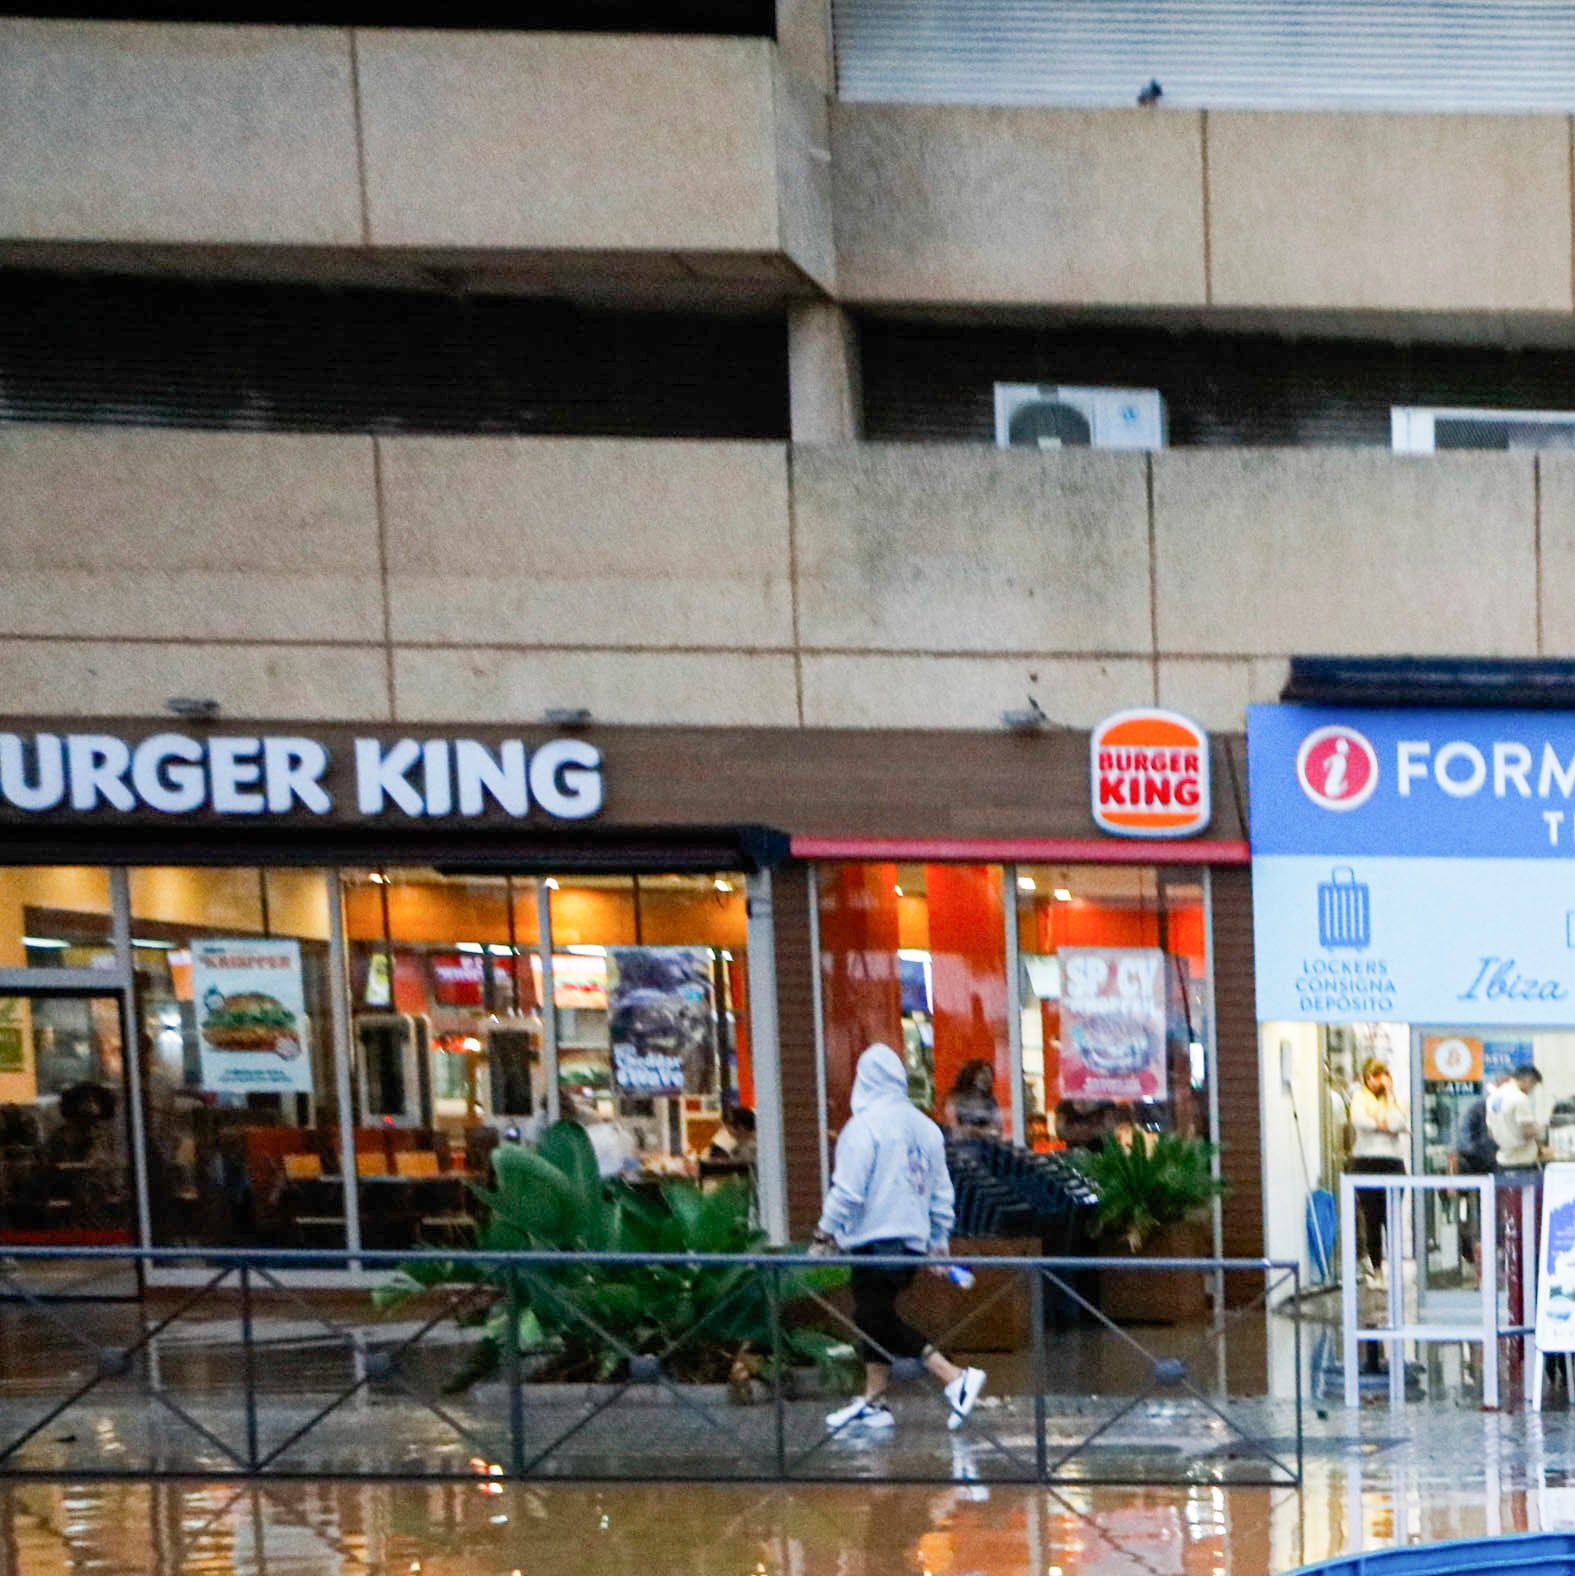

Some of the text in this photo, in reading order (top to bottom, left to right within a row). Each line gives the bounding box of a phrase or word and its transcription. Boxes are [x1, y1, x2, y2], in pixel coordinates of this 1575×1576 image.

[1098, 751, 1199, 772] BURGER
[354, 738, 603, 819] KING
[1100, 775, 1200, 806] KING
[1302, 958, 1388, 974] LOCKERS
[1457, 955, 1568, 1001] Ibiza
[1295, 977, 1397, 993] CONSIGNA
